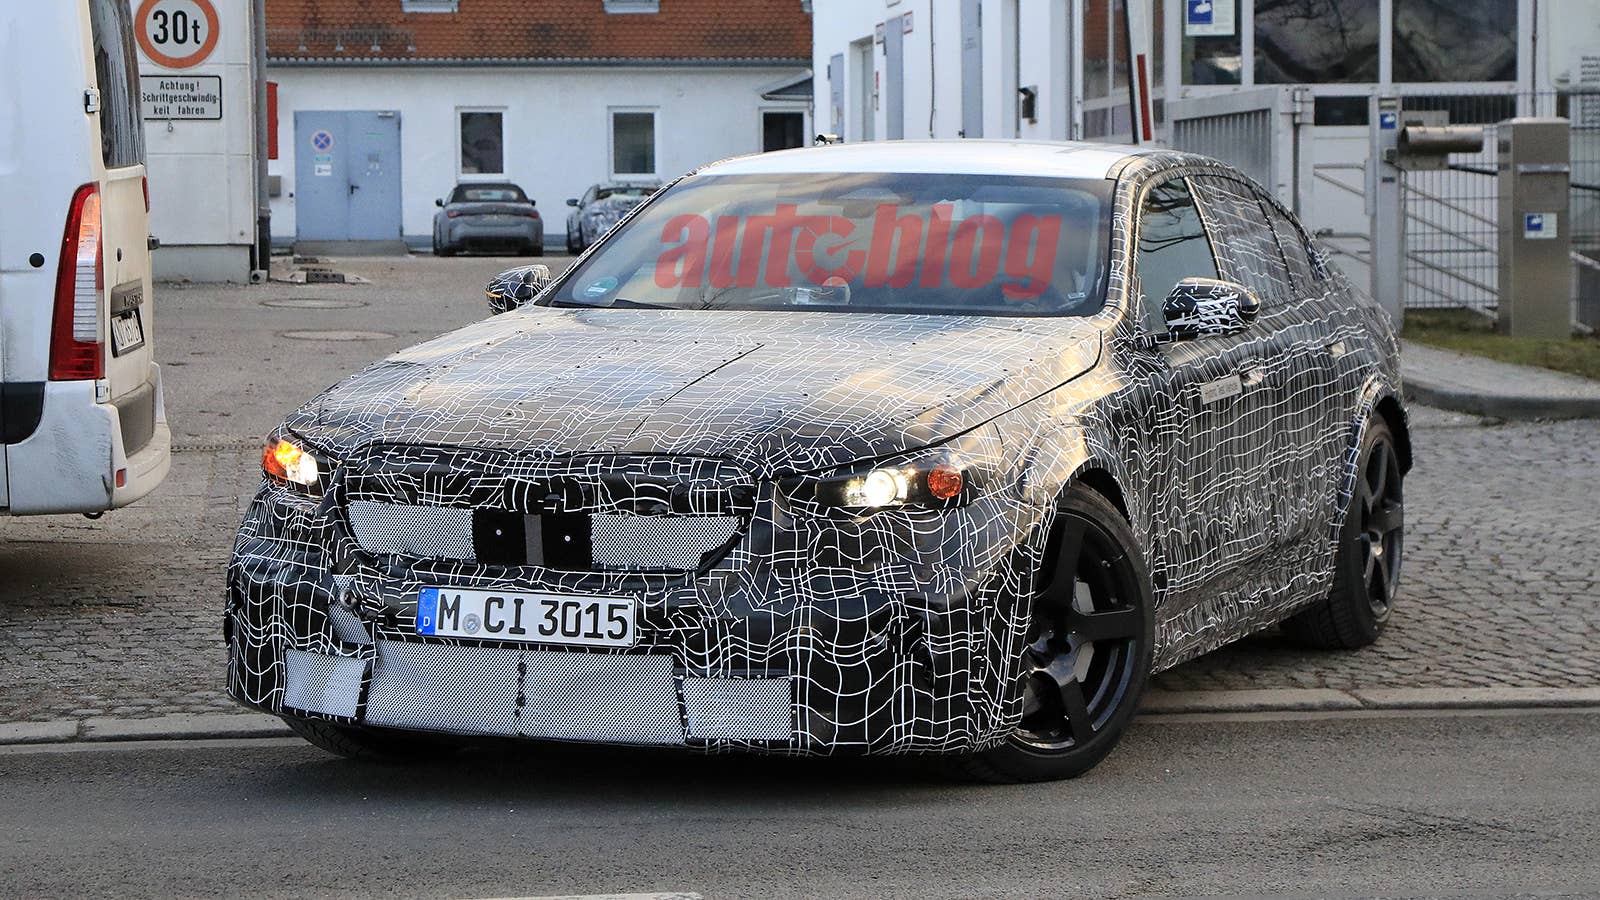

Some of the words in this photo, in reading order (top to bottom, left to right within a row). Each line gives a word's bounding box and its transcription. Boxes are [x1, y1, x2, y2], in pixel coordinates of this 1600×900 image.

[142, 92, 219, 104] Schrittgeschwindig-
[153, 105, 170, 115] keit
[178, 105, 205, 115] fahren
[423, 616, 431, 627] D
[438, 593, 461, 631] M
[483, 596, 526, 635] CI
[538, 599, 629, 640] 3015
